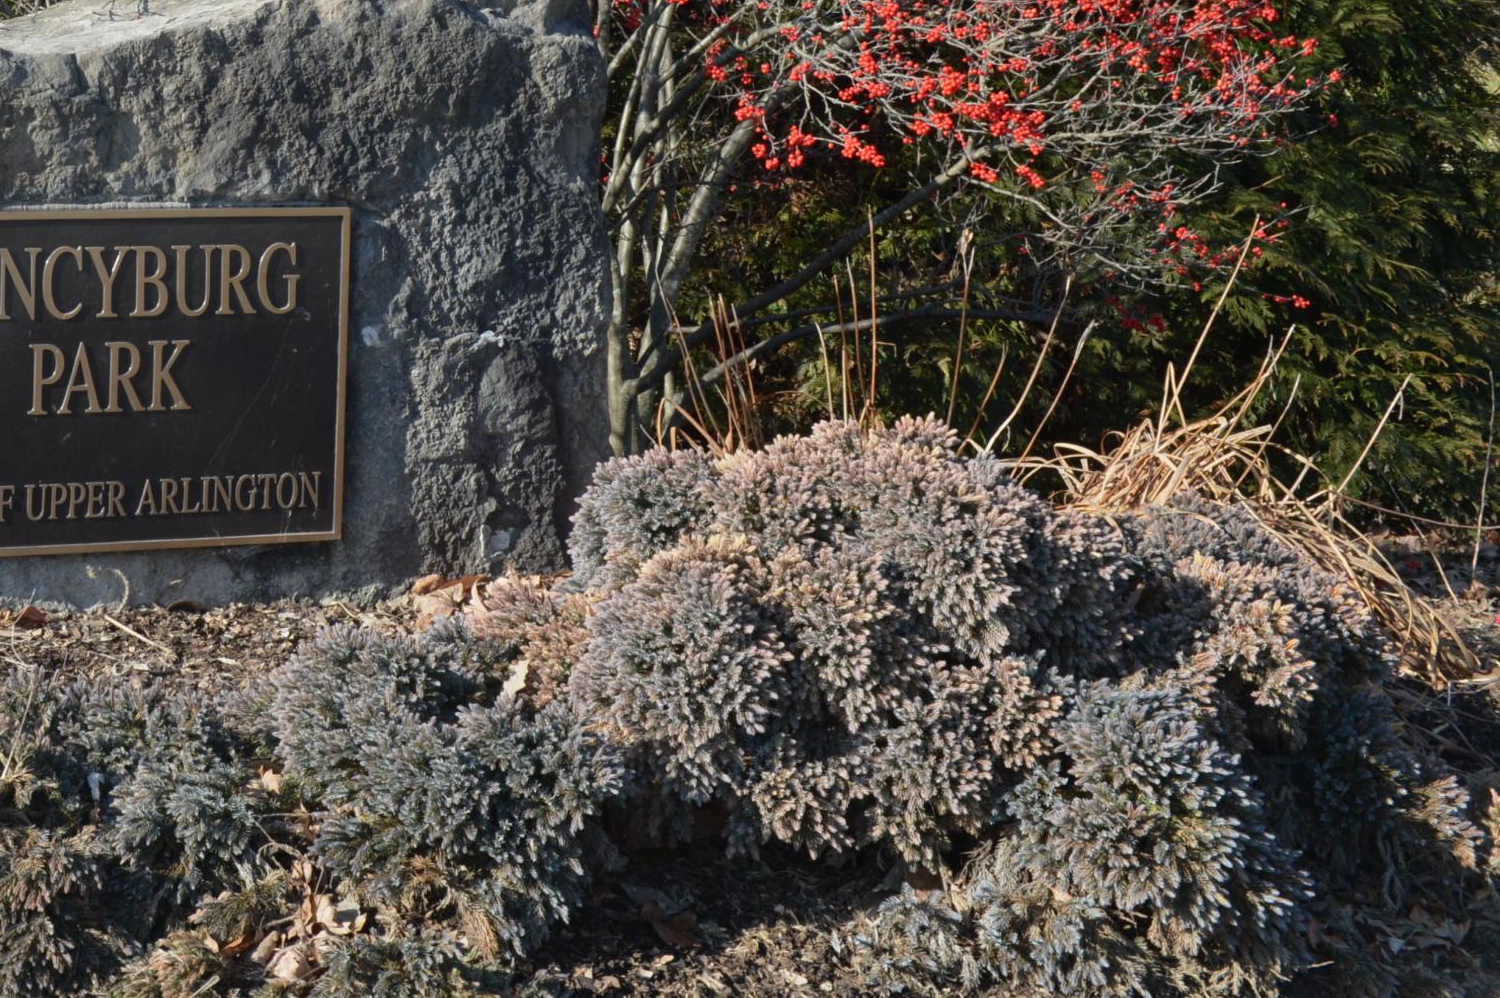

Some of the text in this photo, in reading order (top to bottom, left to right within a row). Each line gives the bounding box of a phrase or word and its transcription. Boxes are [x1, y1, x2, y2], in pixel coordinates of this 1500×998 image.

[26, 339, 193, 416] PARK
[24, 480, 128, 522] UPPER
[135, 471, 323, 517] ARLINGTON
